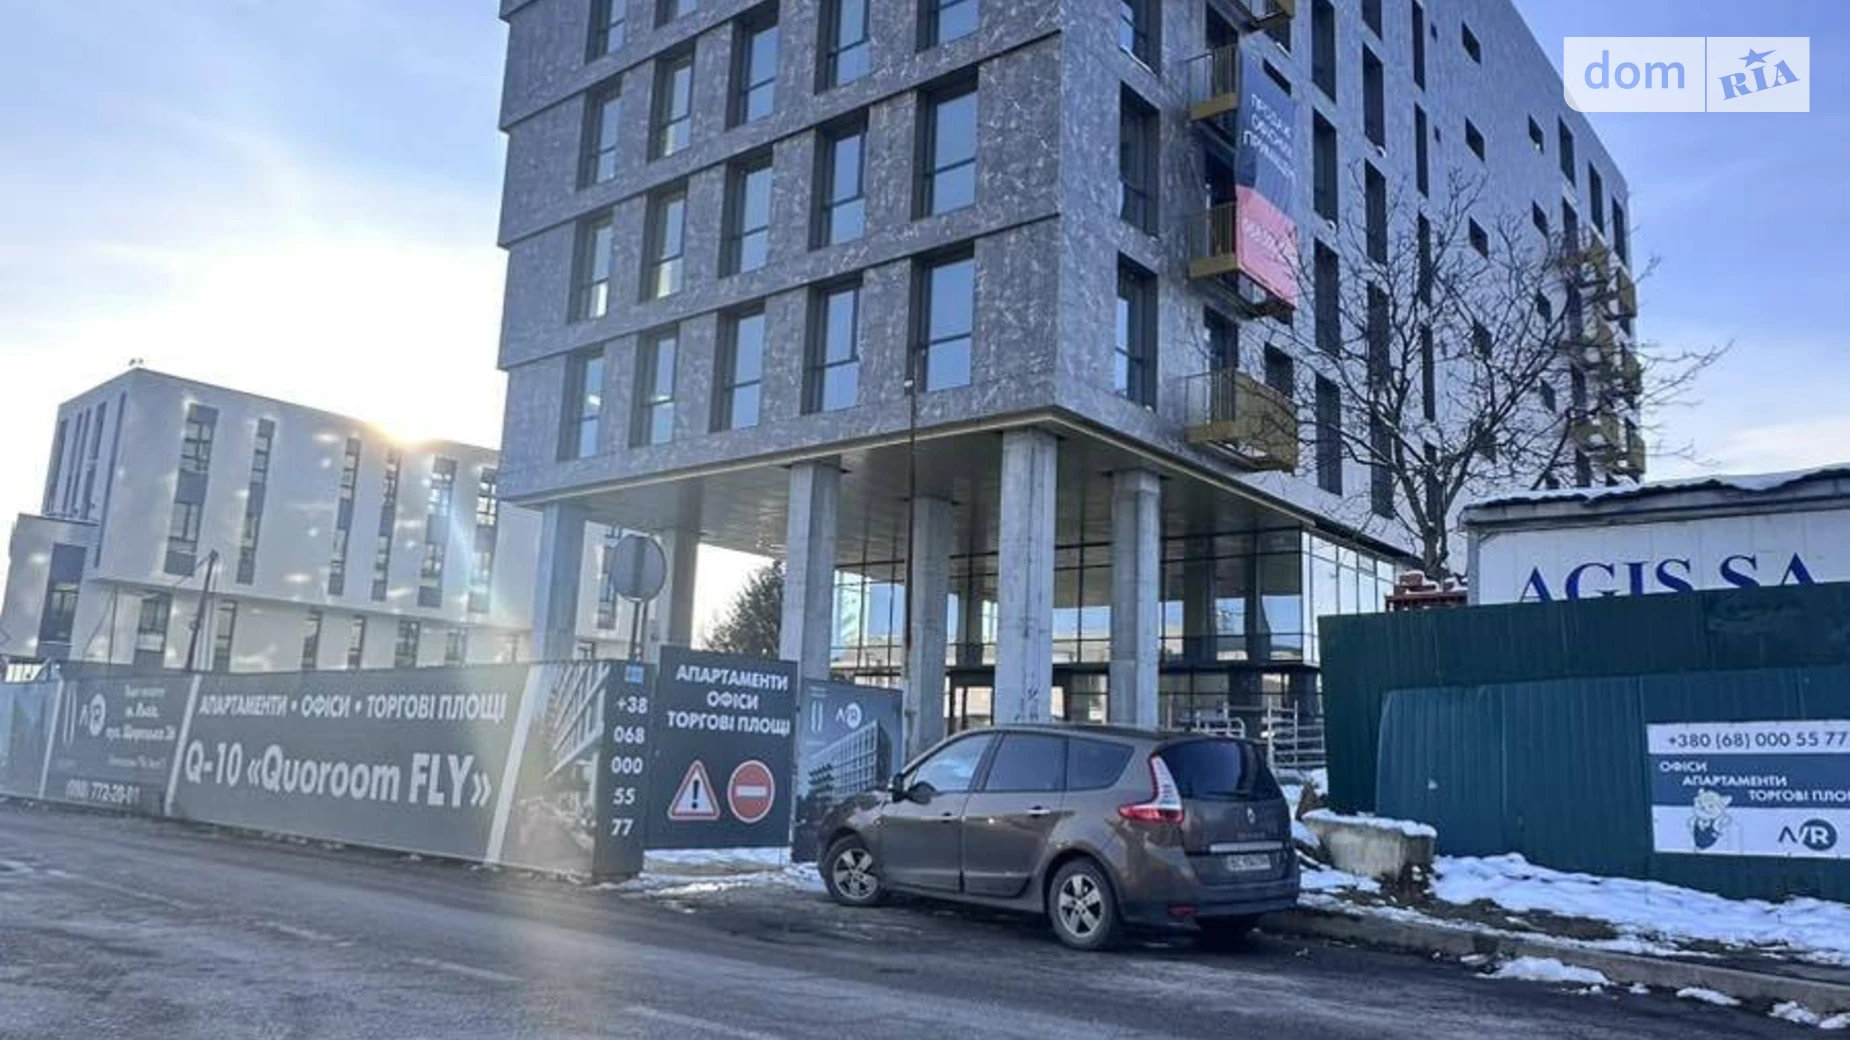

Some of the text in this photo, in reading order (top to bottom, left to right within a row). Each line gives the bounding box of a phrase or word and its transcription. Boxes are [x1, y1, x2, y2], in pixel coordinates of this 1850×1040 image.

[1519, 552, 1817, 603] AGIS SA
[675, 664, 788, 692] АПАРТАМЕНТИ
[199, 693, 508, 724] АПАРТАМЕНТИ ОФІСИ ТОРГОВІ ПЛОЩІ
[616, 696, 648, 714] +38
[706, 691, 759, 711] ОФІСИ
[667, 710, 791, 737] ТОРГОВІ ПЛОЩІ
[614, 726, 645, 744] 068
[1669, 731, 1848, 750] +380 (68) 000 55 77
[185, 740, 492, 808] Q-10 «Quoroom FLY»
[611, 756, 643, 774] 000
[1659, 760, 1707, 773] ОФІСИ
[1682, 775, 1787, 787] АПАРТАМЕНТИ
[613, 787, 636, 805] 55
[1749, 788, 1850, 801] ТОРГОВІ ПЛО
[611, 818, 634, 836] 77
